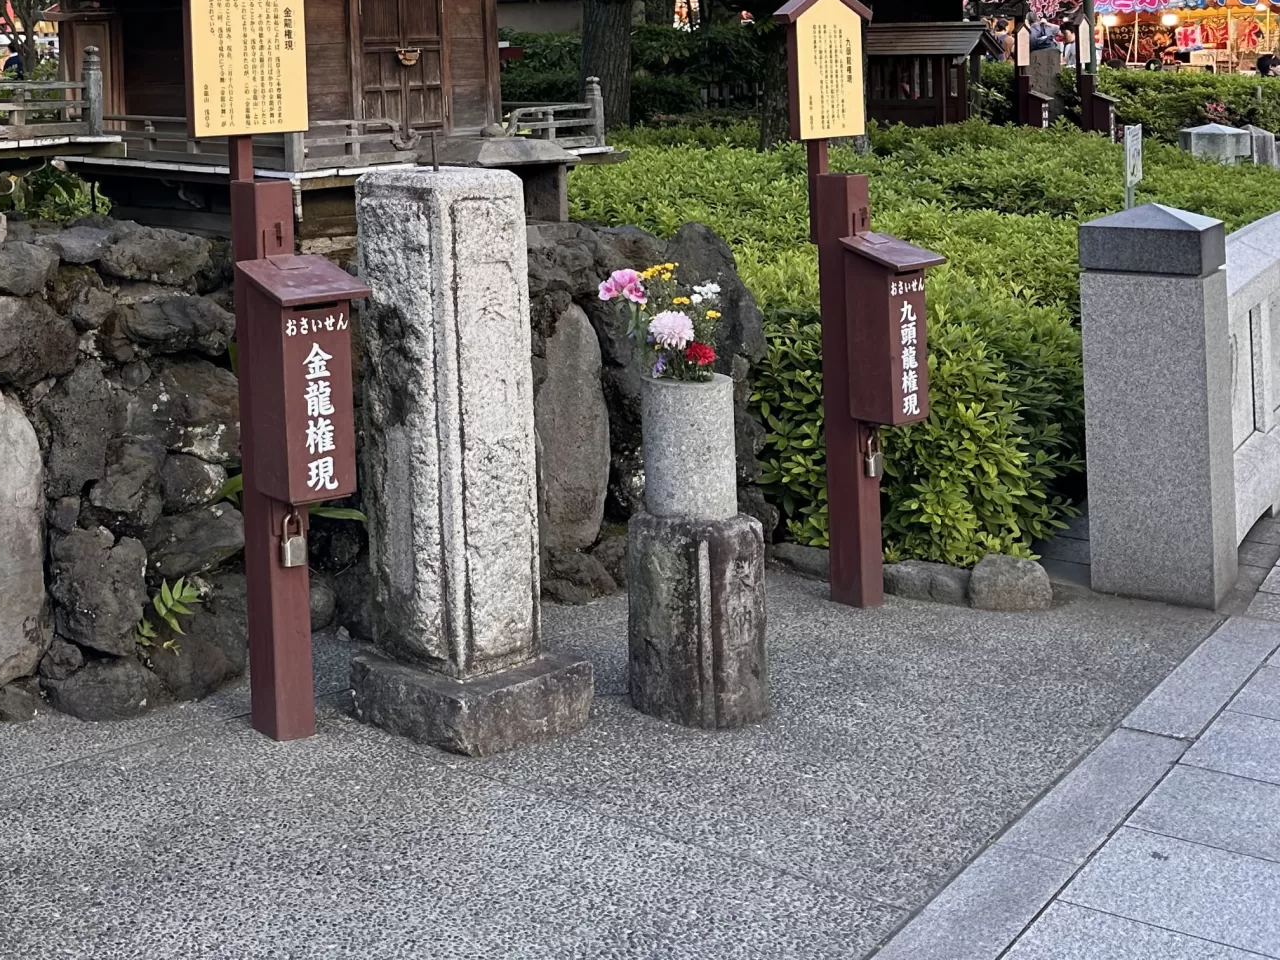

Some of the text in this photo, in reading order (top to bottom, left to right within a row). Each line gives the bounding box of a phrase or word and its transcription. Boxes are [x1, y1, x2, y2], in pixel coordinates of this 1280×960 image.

[283, 6, 294, 51] 金龍権現
[890, 278, 924, 296] おさいせん
[285, 313, 349, 337] おさいせん
[900, 300, 920, 415] 九頭龍権現
[302, 343, 339, 491] 金龍権現
